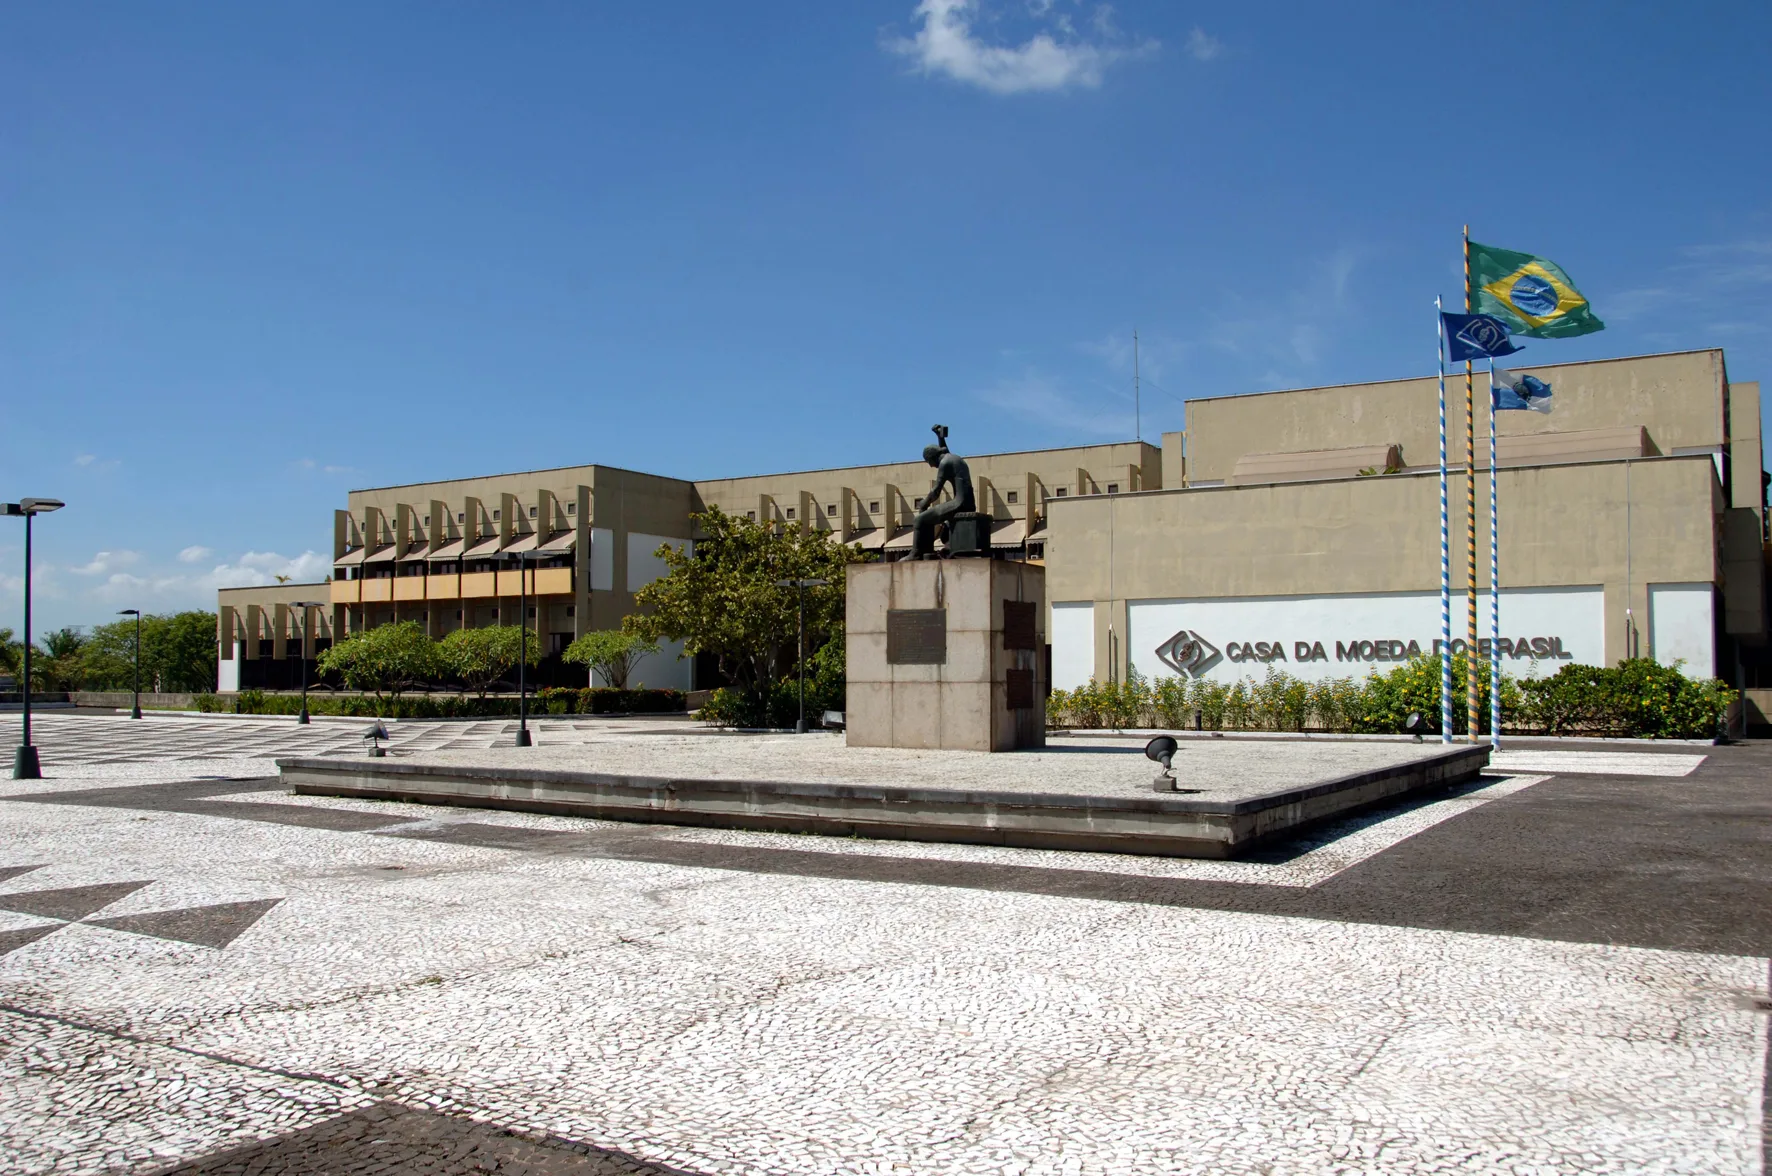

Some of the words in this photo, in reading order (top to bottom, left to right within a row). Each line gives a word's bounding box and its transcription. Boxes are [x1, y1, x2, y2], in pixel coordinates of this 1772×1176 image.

[1226, 641, 1287, 662] CASA
[1295, 641, 1328, 662] DA
[1336, 639, 1421, 661] MOEDA
[1477, 637, 1571, 659] BRASIL
